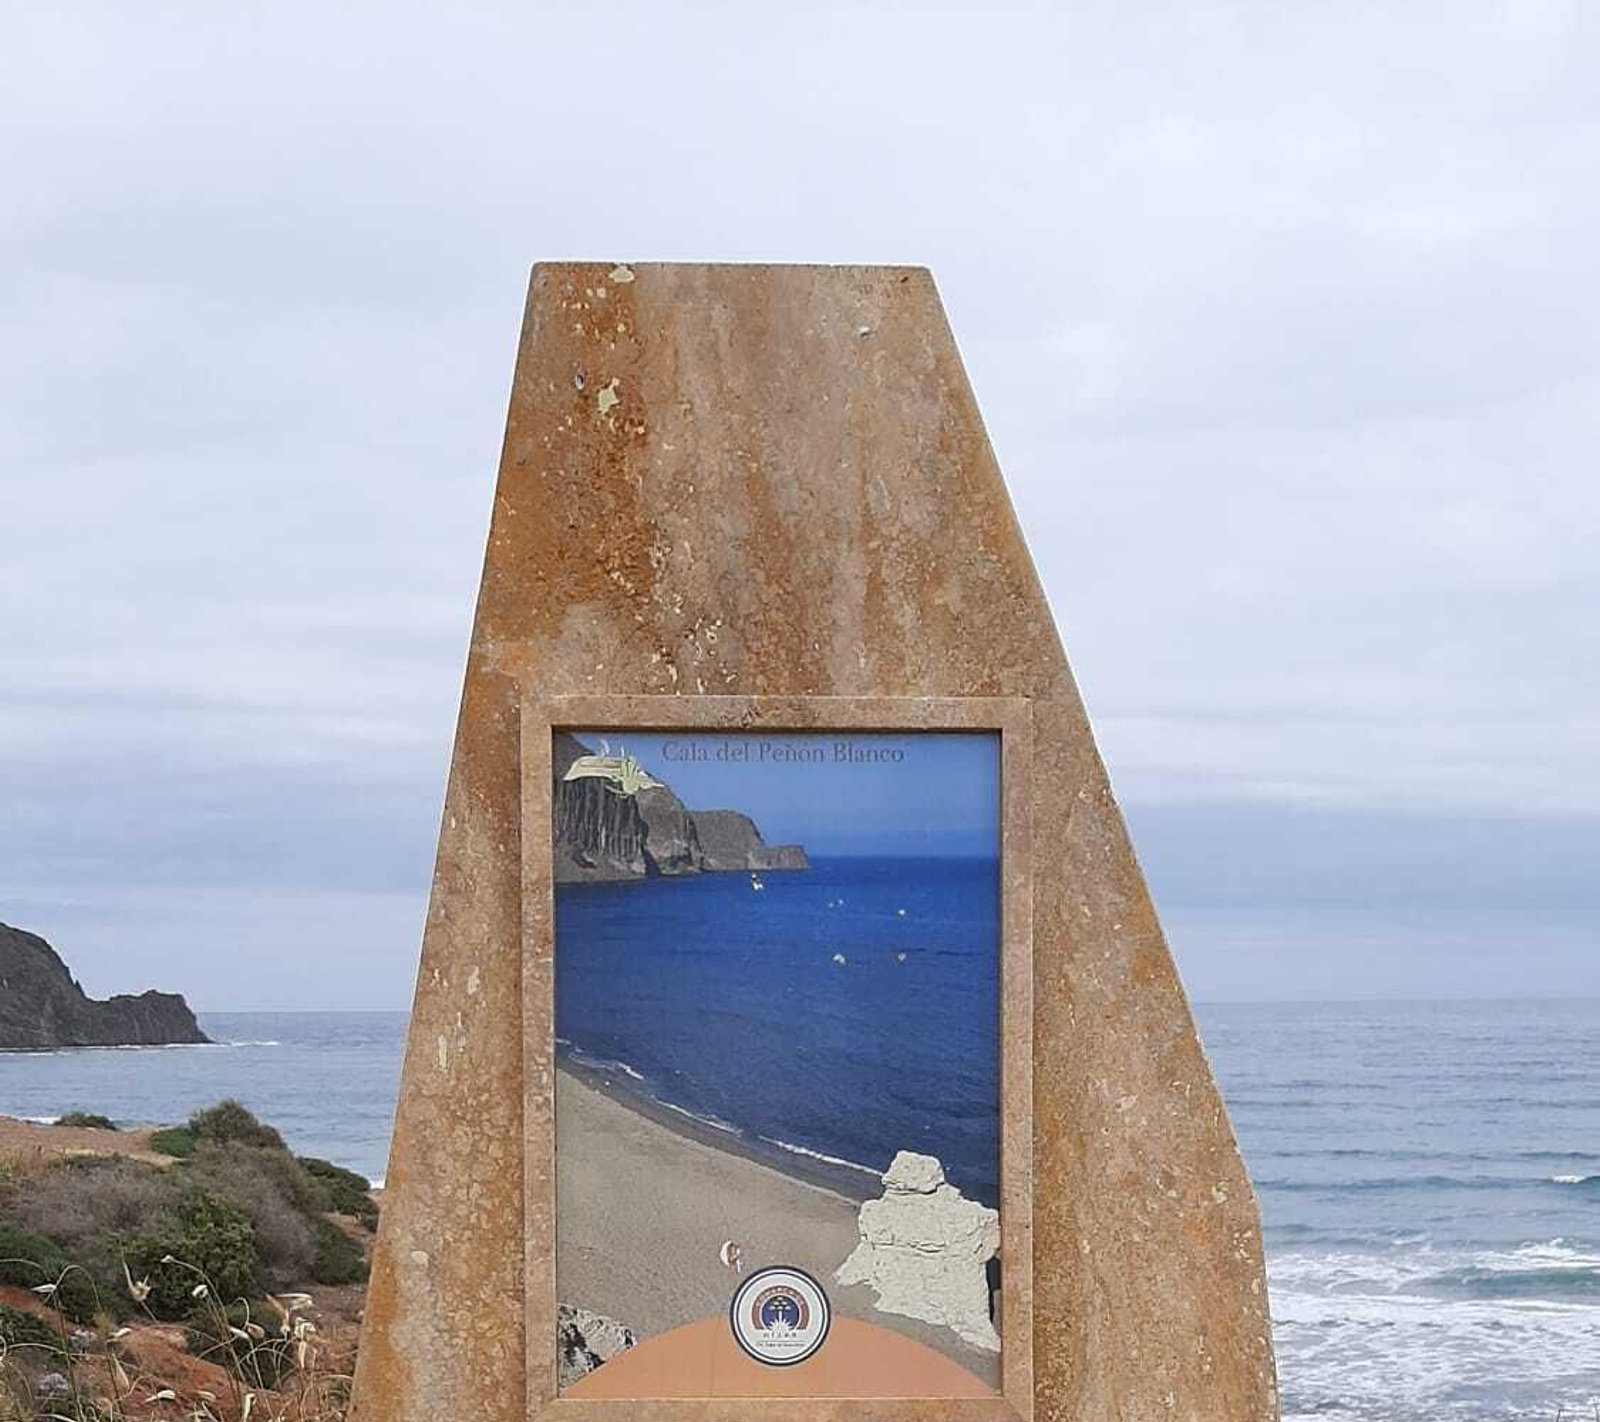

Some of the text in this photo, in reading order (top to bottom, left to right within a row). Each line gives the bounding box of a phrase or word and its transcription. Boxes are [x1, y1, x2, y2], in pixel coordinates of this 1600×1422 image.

[661, 740, 905, 763] Cala del Peñón Blanco
